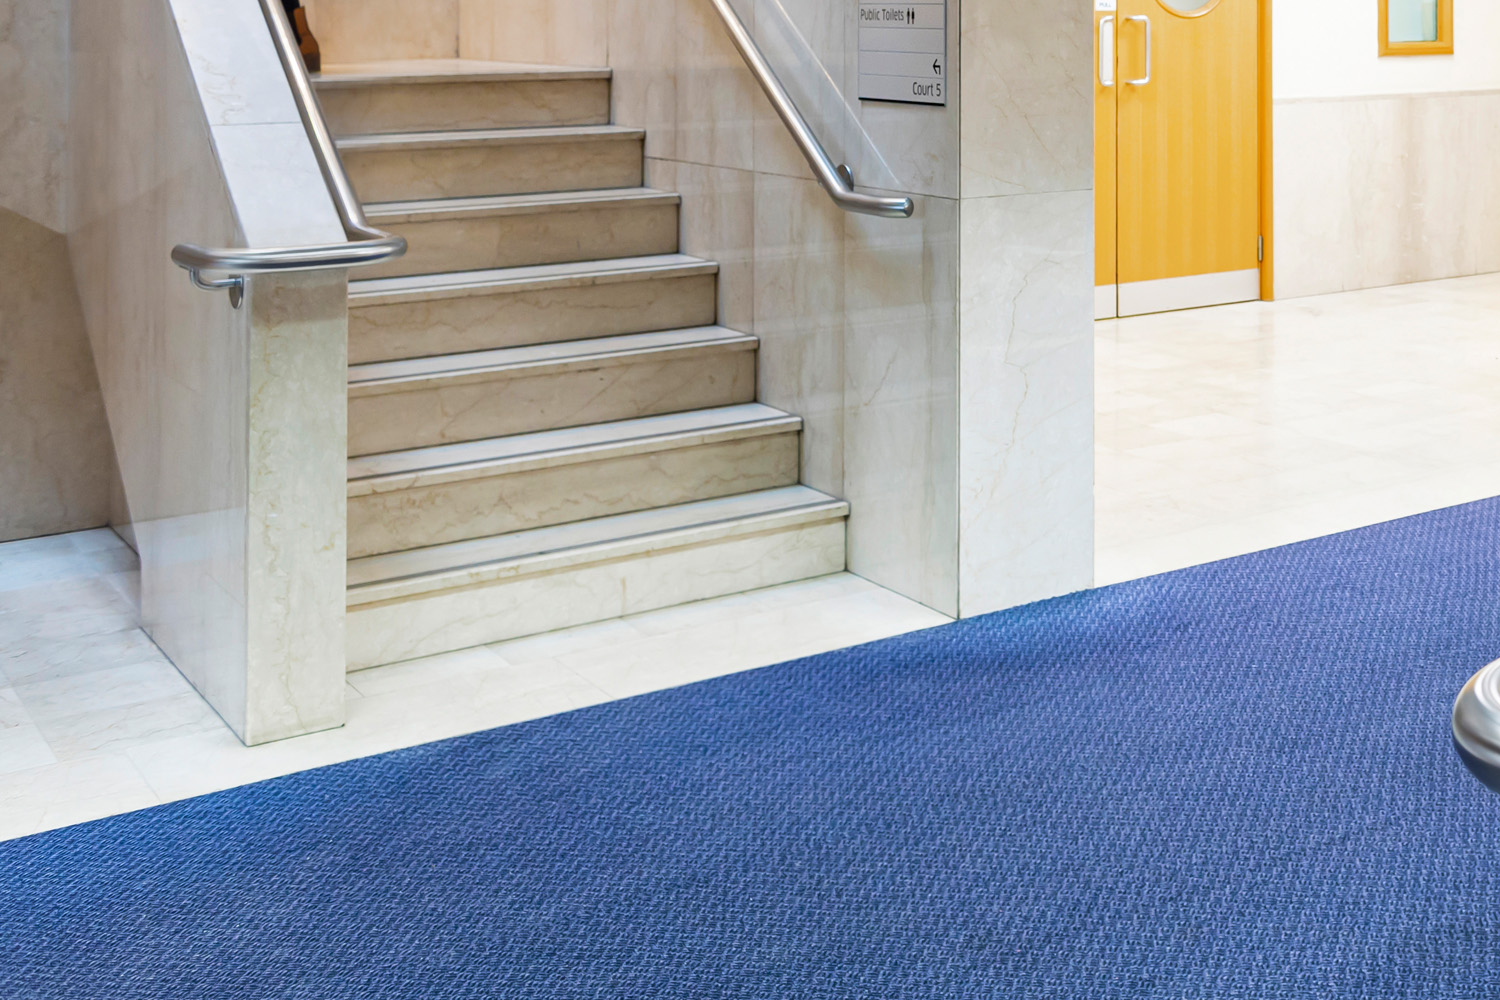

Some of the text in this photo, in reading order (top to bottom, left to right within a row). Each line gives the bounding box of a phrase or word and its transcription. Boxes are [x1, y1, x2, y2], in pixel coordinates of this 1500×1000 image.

[860, 8, 905, 22] Public Toilets
[912, 81, 942, 98] Court 5
